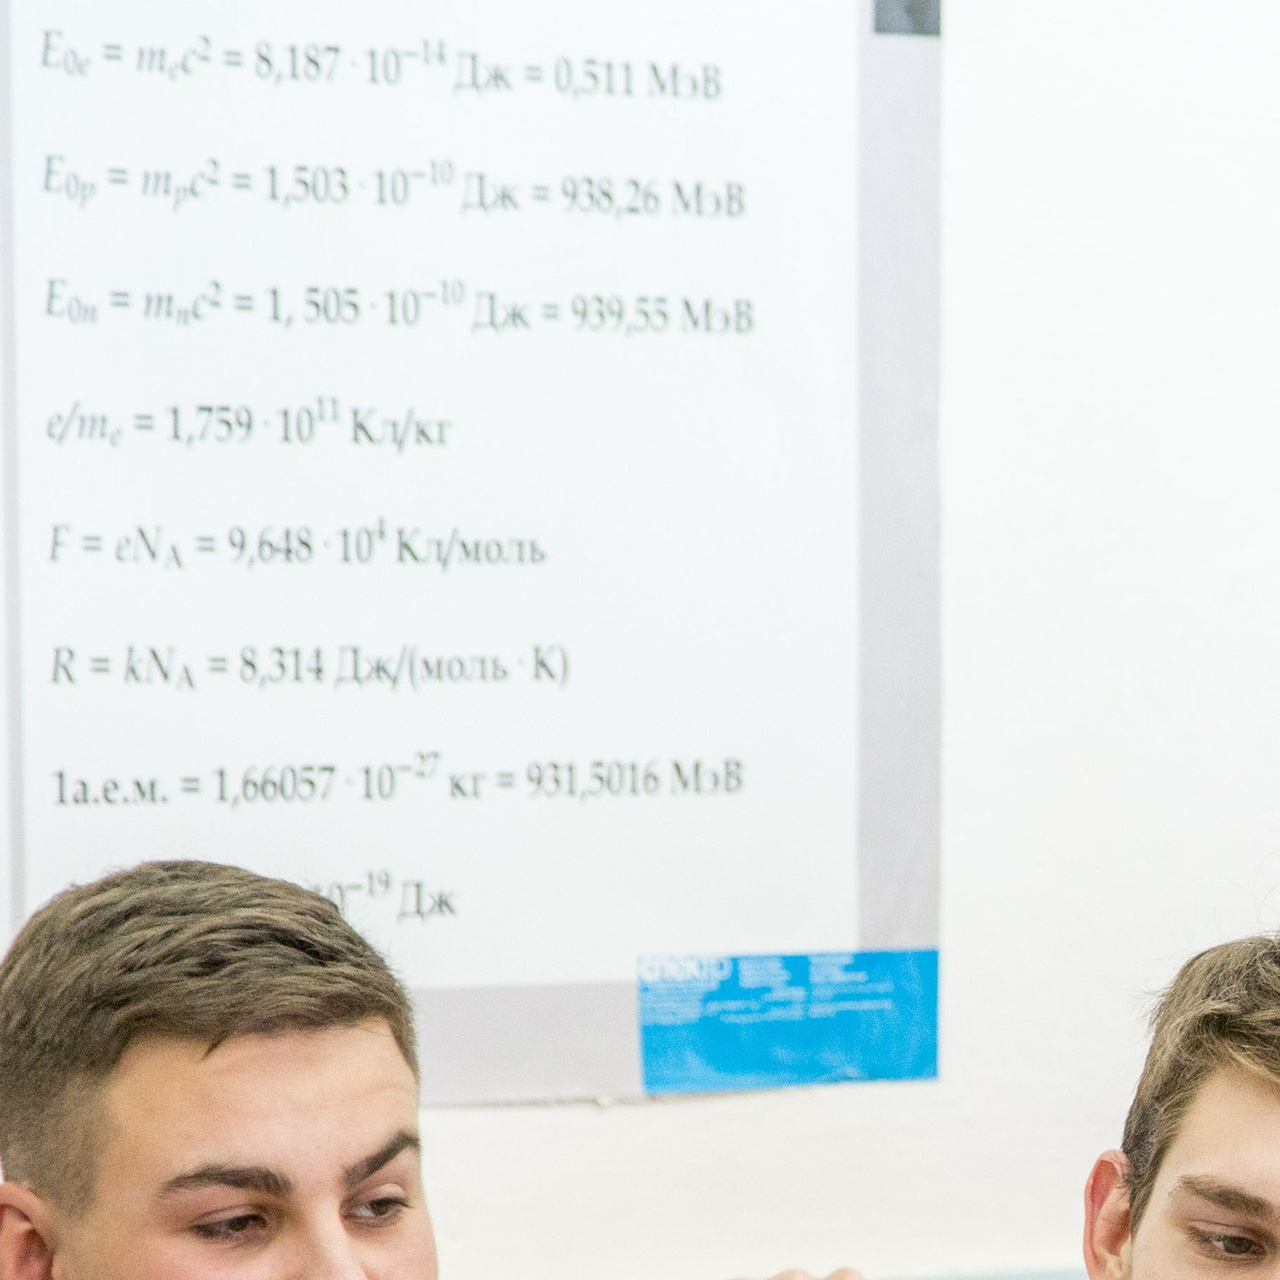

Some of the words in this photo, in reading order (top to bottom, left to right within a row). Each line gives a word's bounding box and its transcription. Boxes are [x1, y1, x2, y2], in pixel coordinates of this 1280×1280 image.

[255, 41, 342, 85] 8,187
[453, 51, 512, 94] Дж
[554, 57, 635, 99] 0,511
[648, 61, 722, 101] МэВ
[265, 164, 350, 208] 1,503
[461, 172, 520, 214] Дж
[561, 176, 661, 218] 938,26
[672, 180, 746, 218] МэВ
[471, 291, 531, 334] Дж
[571, 294, 670, 336] 939,55
[681, 297, 754, 335] МэВ
[166, 404, 255, 448] 1,759
[350, 407, 451, 454] Кл/кг
[49, 523, 71, 563] F
[227, 525, 315, 569] 9,648
[396, 526, 547, 573] Кл/моль
[50, 646, 77, 685] R
[239, 645, 325, 689] 8,314
[212, 763, 338, 810] 1,66057
[449, 773, 486, 800] кг
[526, 760, 661, 801] 931,5016
[671, 757, 744, 796] МэВ
[396, 880, 458, 924] Дж
